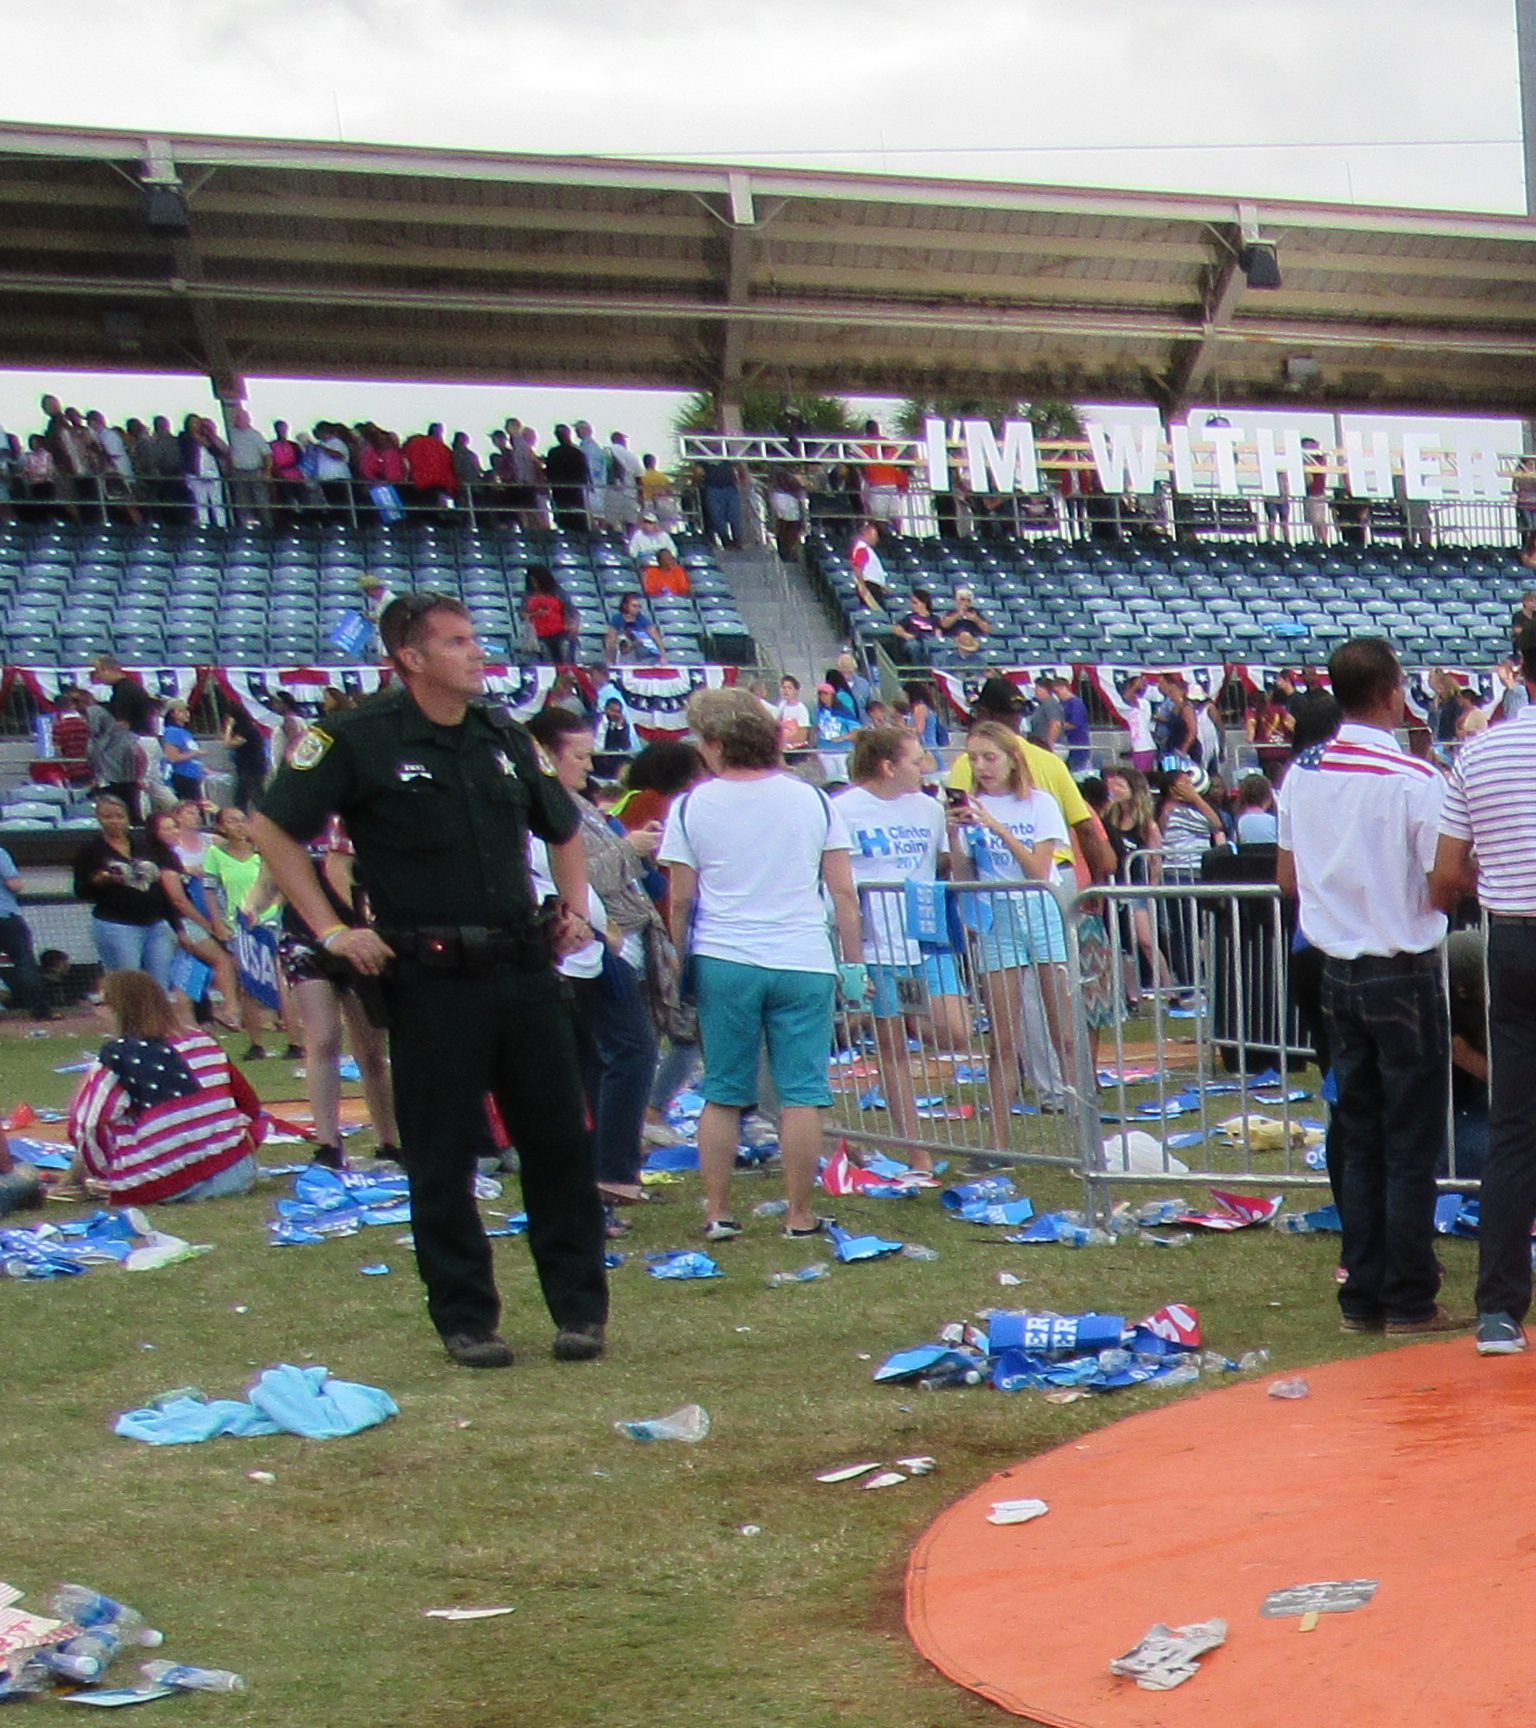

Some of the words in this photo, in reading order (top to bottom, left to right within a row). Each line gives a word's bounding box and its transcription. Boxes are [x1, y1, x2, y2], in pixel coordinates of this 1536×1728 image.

[925, 417, 1041, 494] I'M
[1086, 421, 1307, 498] WITH
[1345, 430, 1514, 503] HER
